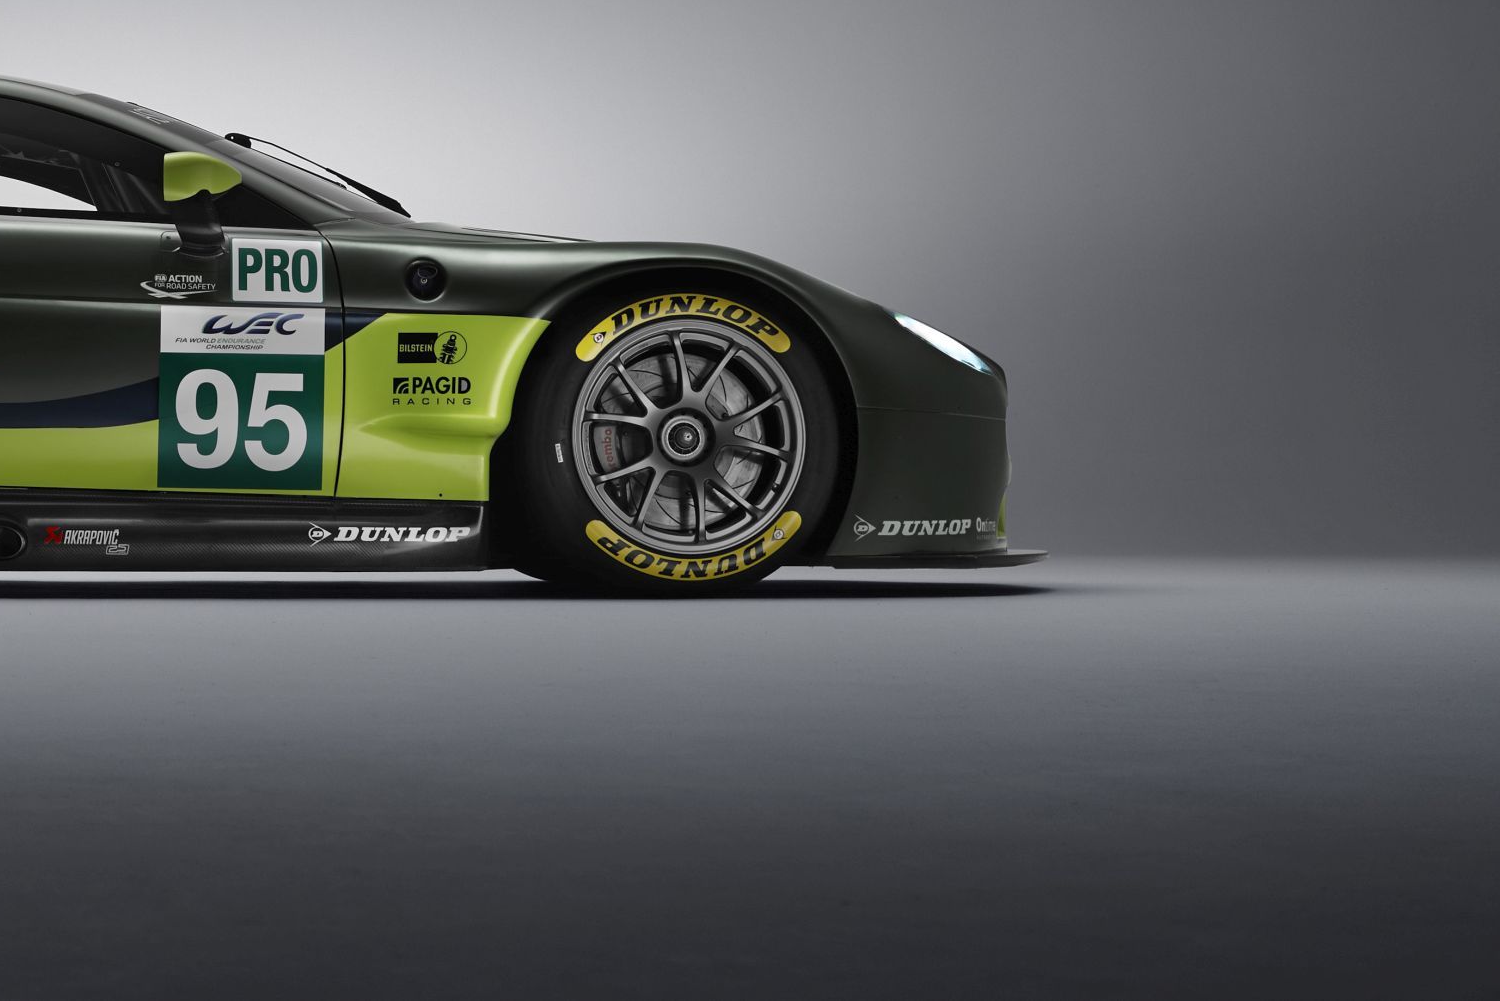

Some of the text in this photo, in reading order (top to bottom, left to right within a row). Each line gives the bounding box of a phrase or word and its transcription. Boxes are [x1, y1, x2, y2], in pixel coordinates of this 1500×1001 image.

[168, 275, 202, 283] ACTION
[237, 247, 318, 293] PRO
[202, 312, 304, 335] WEC
[612, 296, 779, 336] DUNLOP
[399, 344, 432, 352] BILSTEIN
[412, 376, 471, 394] PAGID
[175, 368, 308, 472] 95
[334, 527, 471, 542] DUNLOP
[877, 519, 971, 536] DUNLOP
[598, 537, 766, 578] DUNLOP
